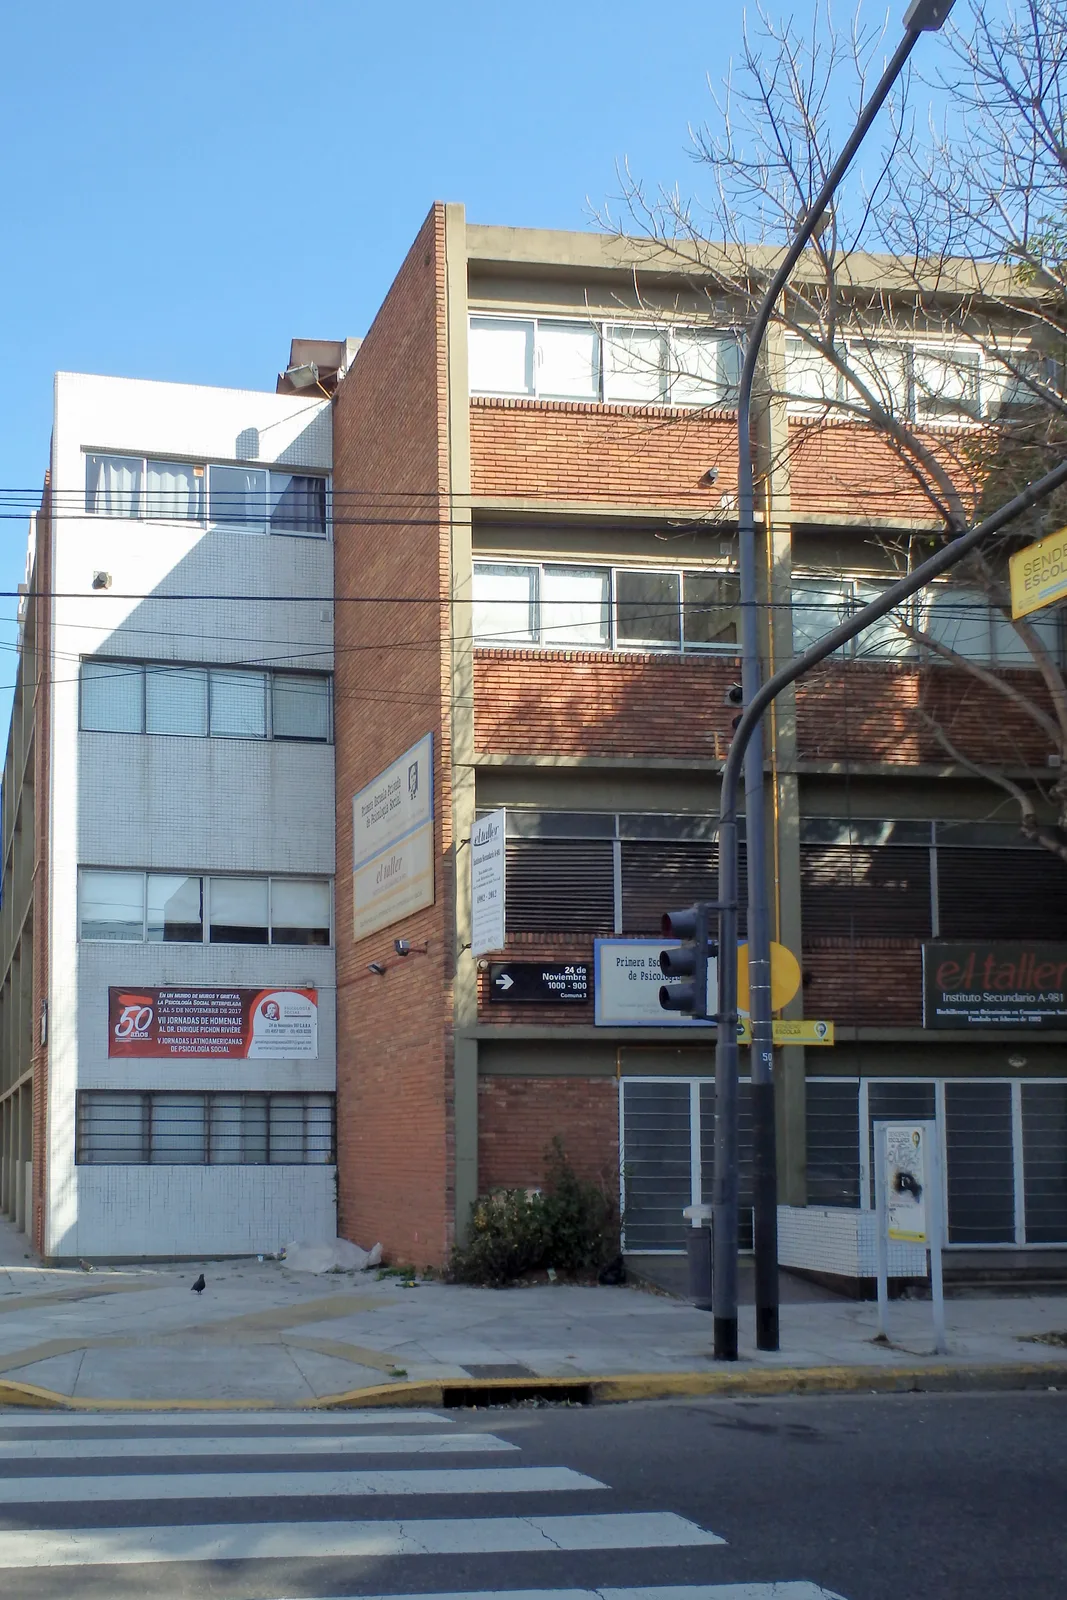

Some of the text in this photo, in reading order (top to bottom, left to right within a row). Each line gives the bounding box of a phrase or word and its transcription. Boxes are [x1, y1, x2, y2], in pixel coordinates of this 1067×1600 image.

[376, 864, 383, 884] el
[384, 856, 402, 880] taller
[616, 957, 645, 967] Primera
[936, 952, 1067, 991] el taller
[628, 971, 637, 980] de
[943, 992, 981, 1002] Instituto
[983, 992, 1035, 1002] Secundario
[115, 1006, 153, 1037] 50
